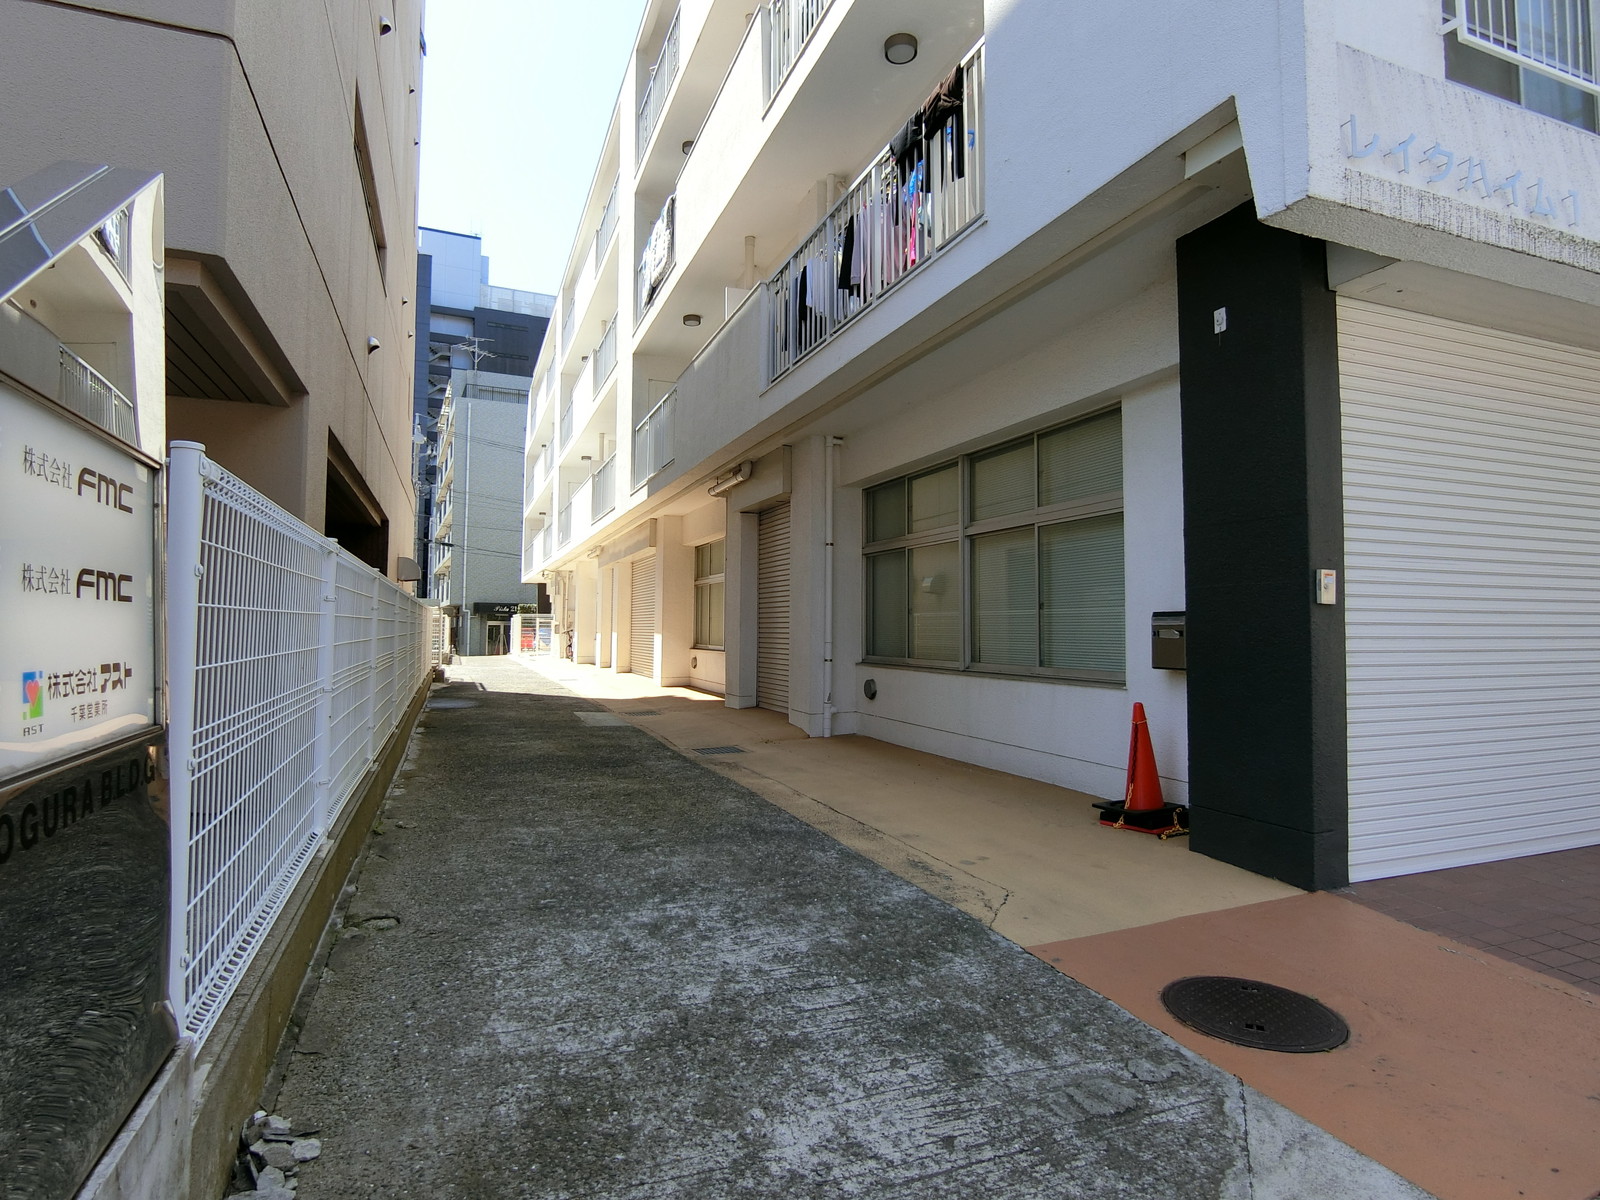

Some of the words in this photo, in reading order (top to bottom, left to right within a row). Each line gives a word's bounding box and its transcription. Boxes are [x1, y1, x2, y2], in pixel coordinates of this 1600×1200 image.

[23, 444, 73, 490] 株式会社
[78, 467, 134, 514] FMC
[22, 562, 71, 595] 株式会社
[76, 568, 133, 603] FMC
[71, 699, 109, 723] 千葉営業所
